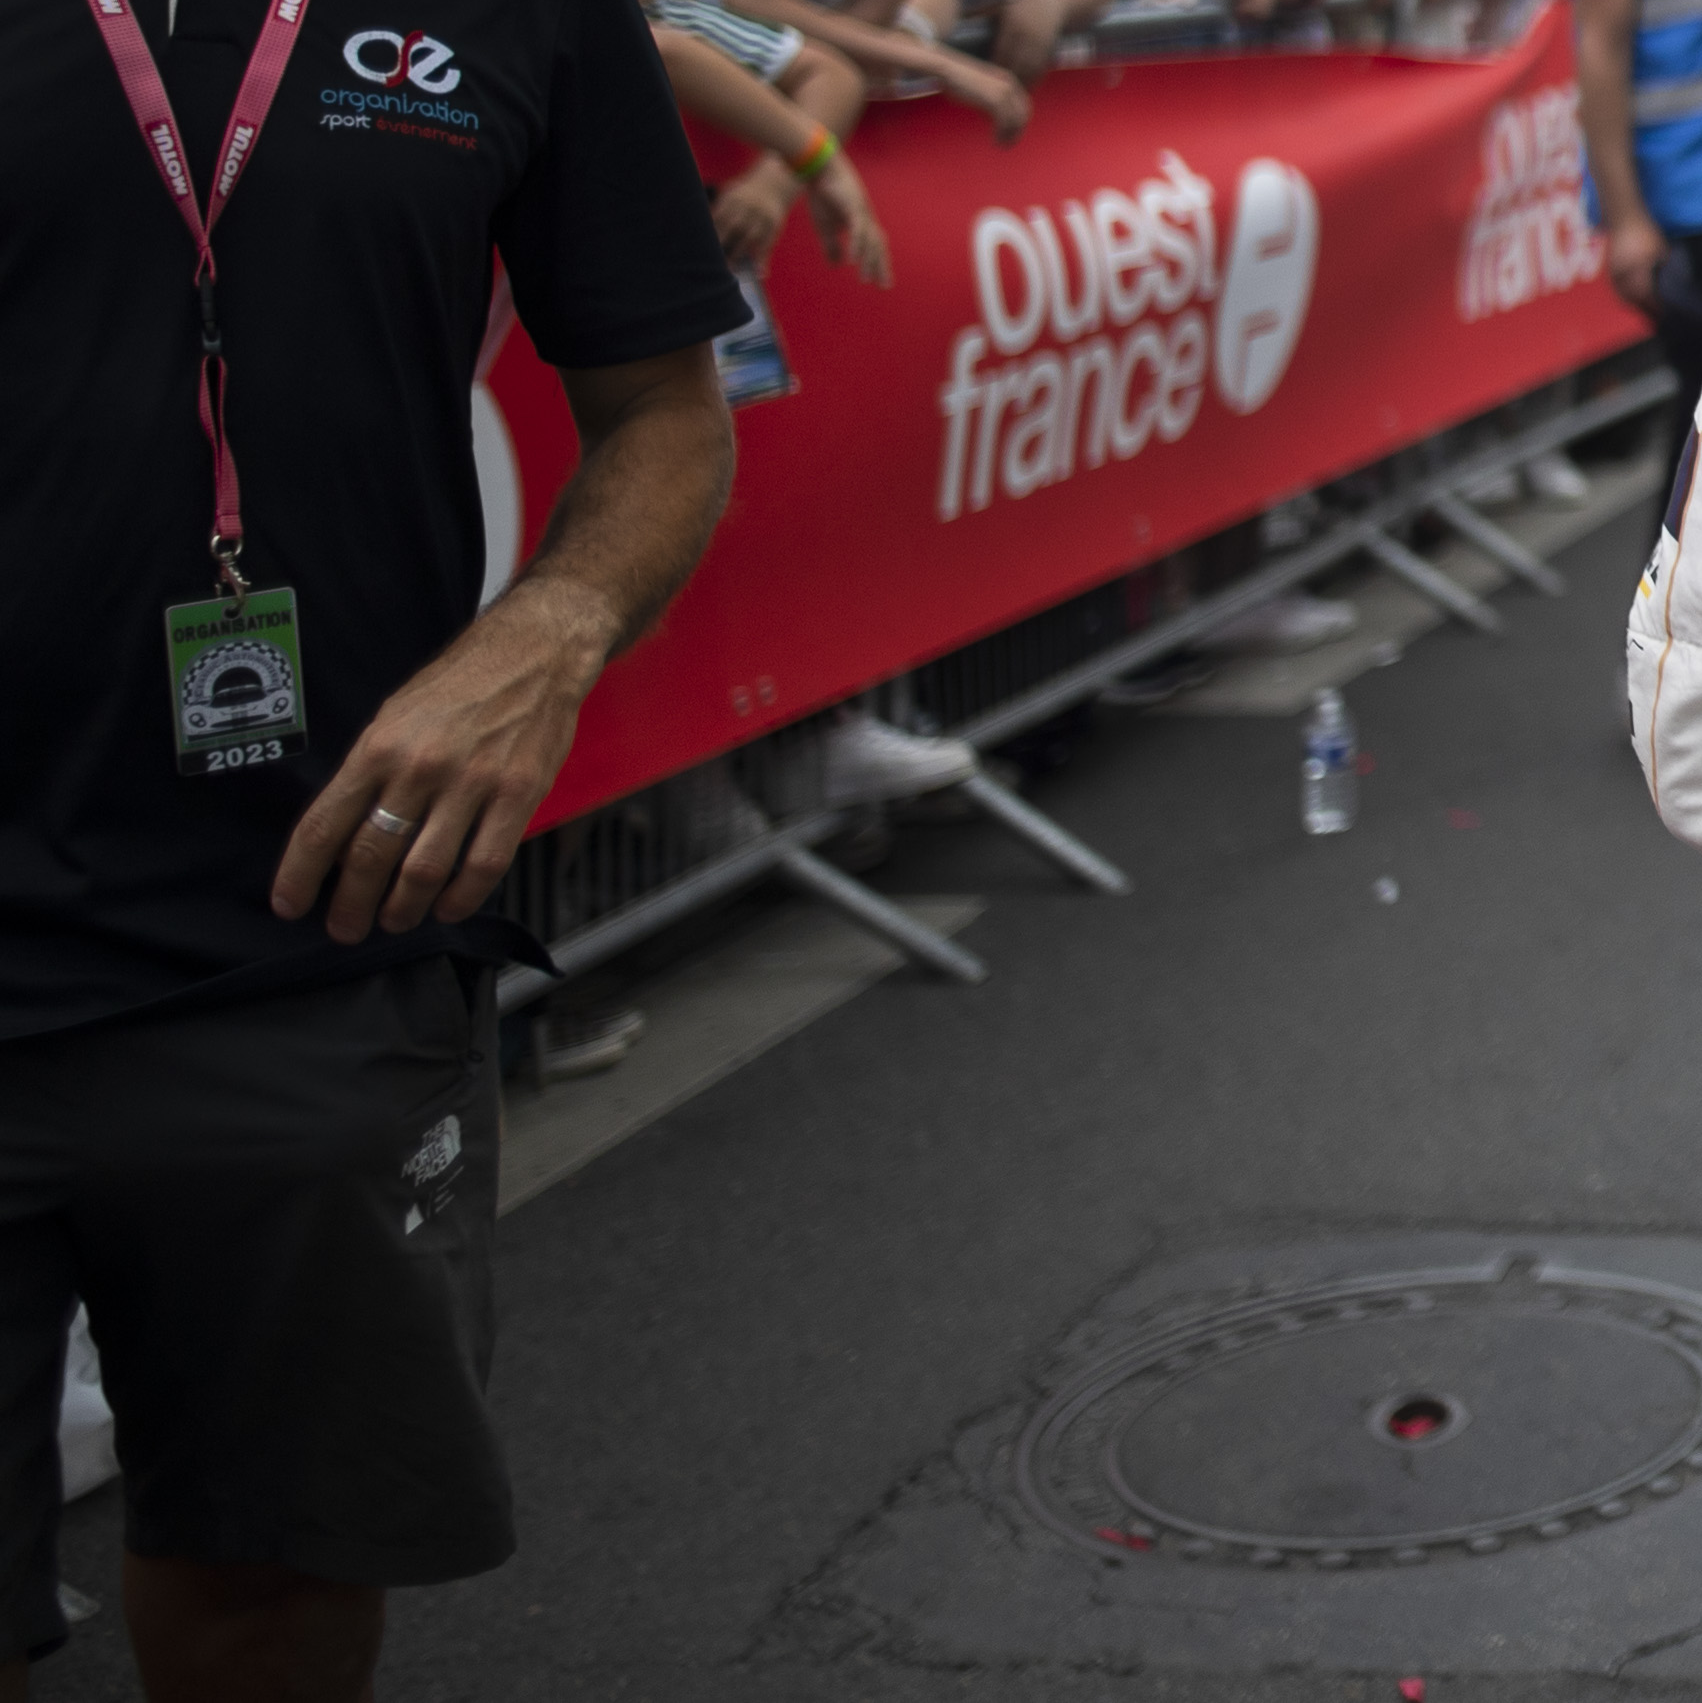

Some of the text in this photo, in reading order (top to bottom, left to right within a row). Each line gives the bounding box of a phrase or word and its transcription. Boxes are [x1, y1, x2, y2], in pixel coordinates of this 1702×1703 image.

[319, 114, 372, 131] sport
[320, 89, 479, 130] organisation
[150, 124, 189, 196] MOTUL
[218, 125, 255, 196] MOTUL
[970, 148, 1222, 358] ouest
[934, 324, 1208, 524] france
[173, 610, 291, 644] ORGANISATION
[206, 740, 283, 772] 2023
[402, 1139, 445, 1179] NORTH
[414, 1153, 447, 1187] FACE
